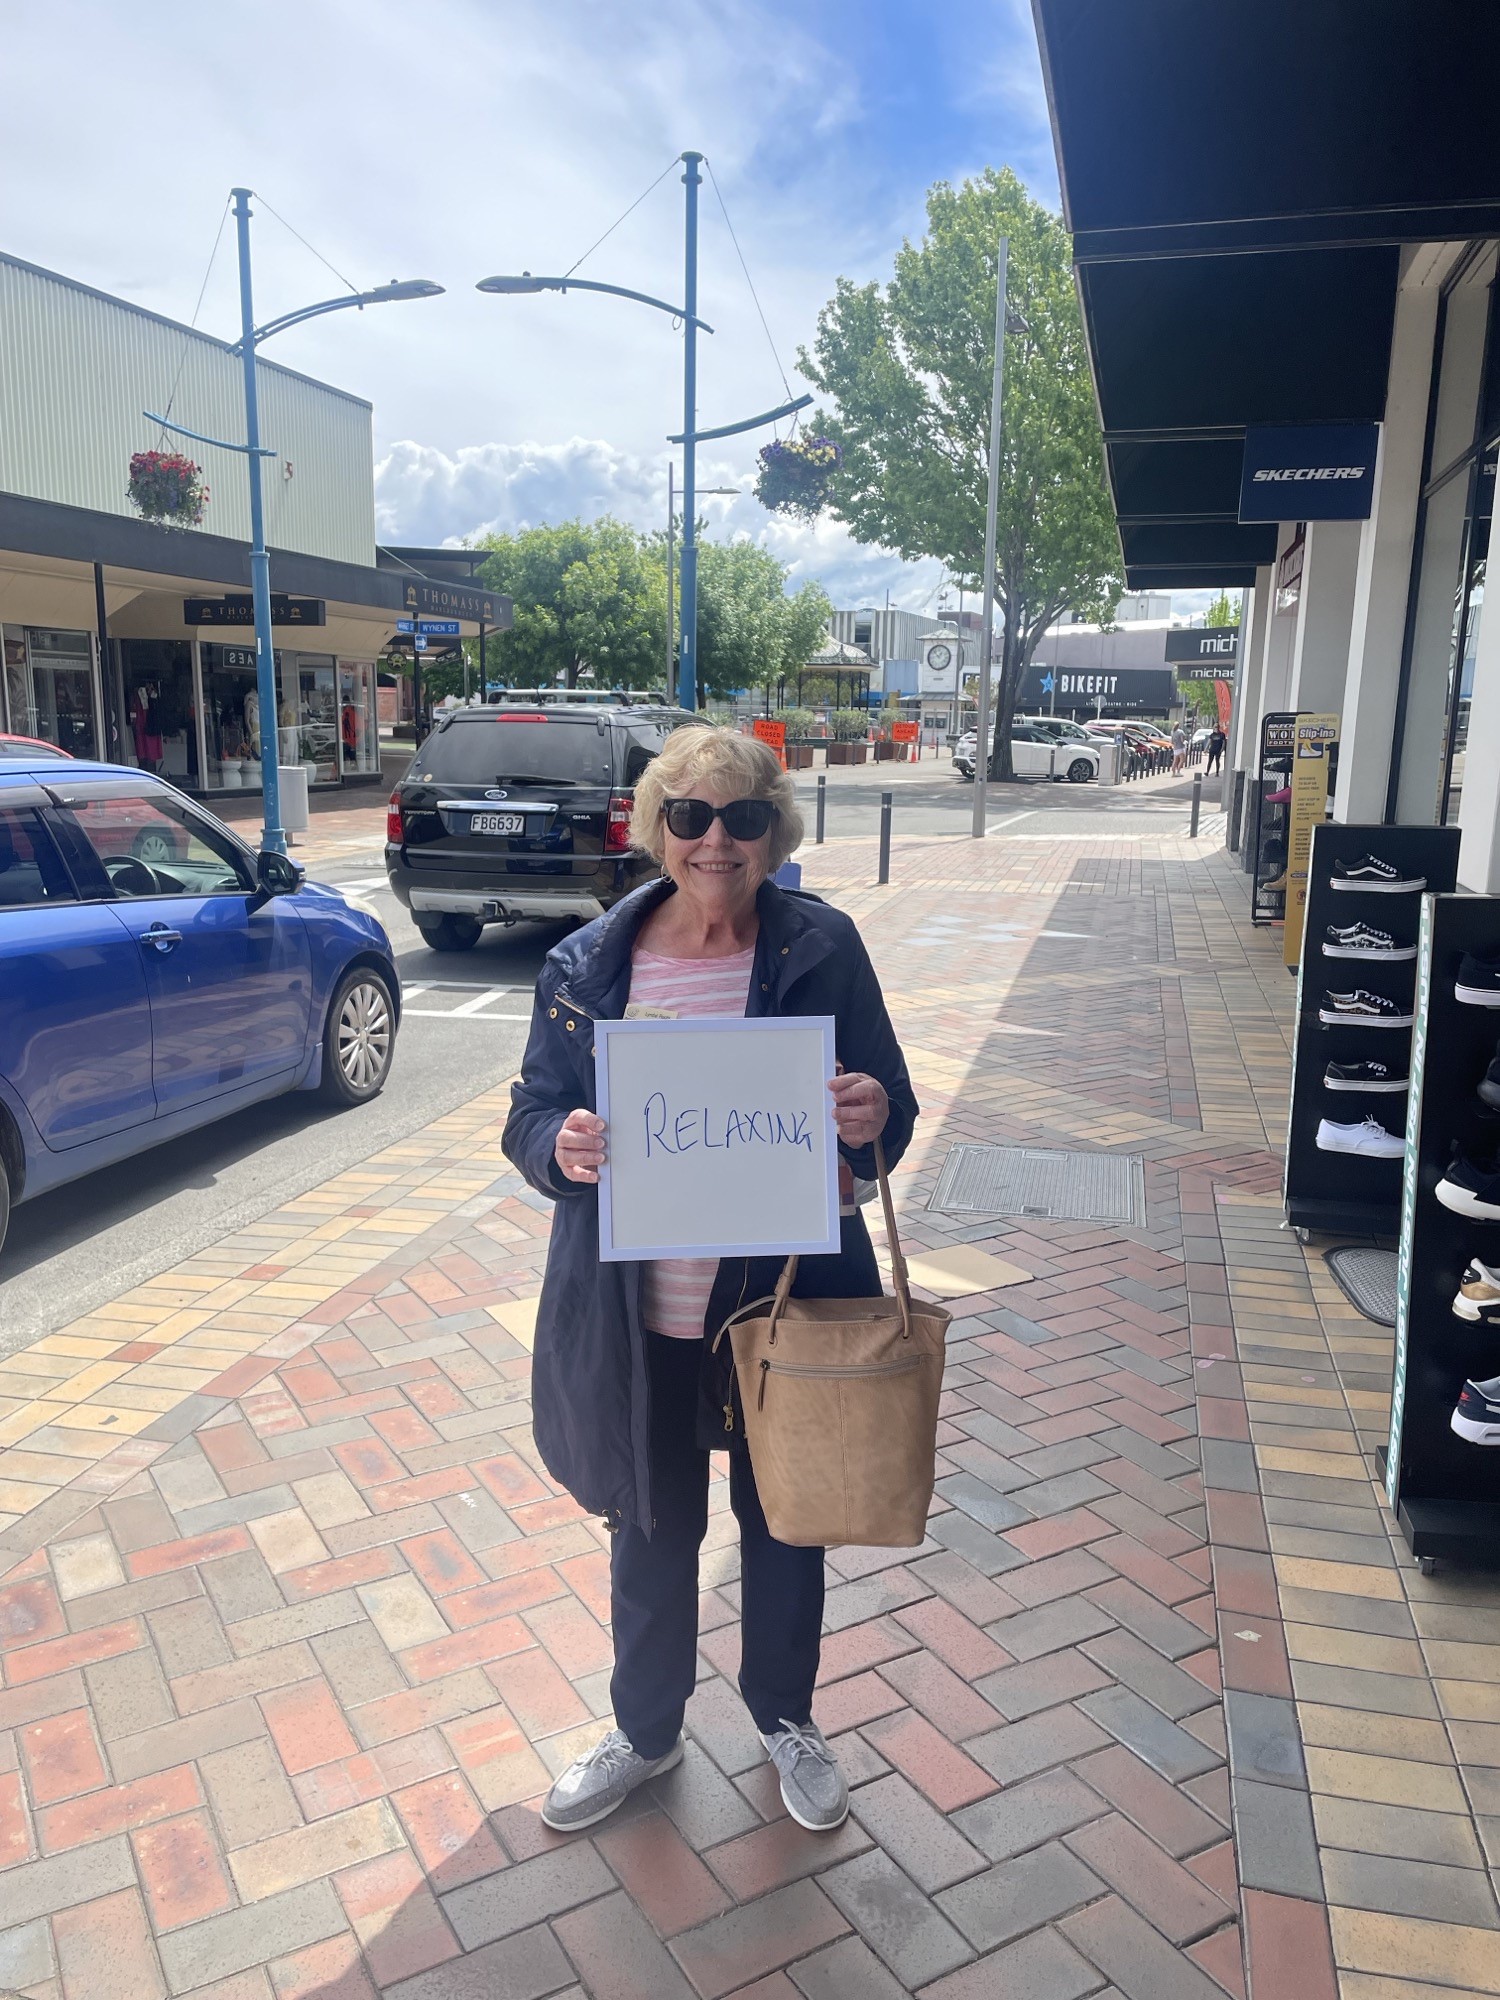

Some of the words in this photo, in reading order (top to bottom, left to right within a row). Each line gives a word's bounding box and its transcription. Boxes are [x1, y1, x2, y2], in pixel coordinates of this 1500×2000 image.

[1252, 466, 1366, 482] SKECHERS
[422, 588, 480, 611] THOMASS
[218, 606, 285, 615] THOSS
[422, 624, 445, 632] WYNEN
[447, 624, 456, 632] ST
[1200, 633, 1239, 653] mich
[1190, 667, 1235, 678] michae
[1061, 674, 1118, 694] BIKEFIT
[756, 730, 781, 738] CLOSED
[1268, 730, 1295, 739] WO
[1299, 728, 1335, 740] Slip-ins
[472, 816, 523, 831] FBG637
[1418, 926, 1430, 1027] JUST
[1407, 1073, 1420, 1146] UST
[1414, 1030, 1424, 1072] IN
[644, 1092, 812, 1158] RELAXING
[1405, 1152, 1415, 1194] IN
[1401, 1201, 1413, 1290] JUST
[1397, 1292, 1407, 1368] UST
[1387, 1411, 1400, 1505] JUST
[1394, 1374, 1404, 1418] IN
